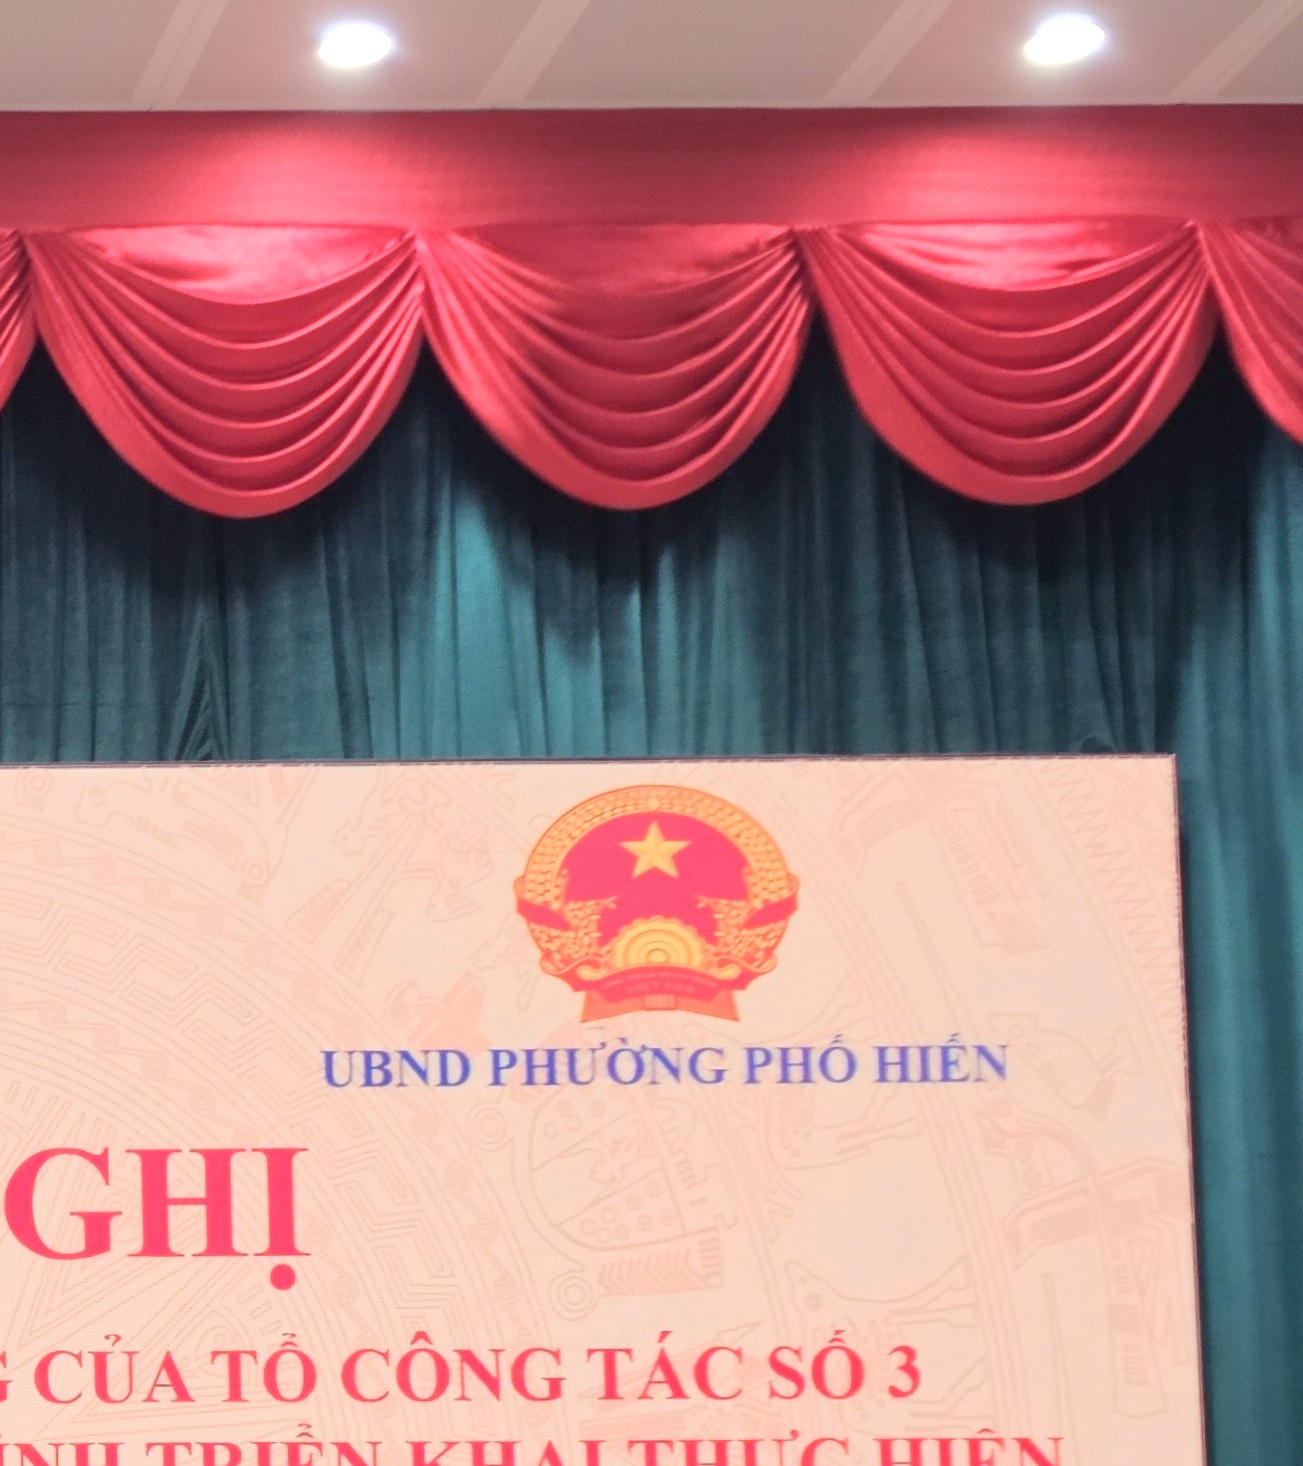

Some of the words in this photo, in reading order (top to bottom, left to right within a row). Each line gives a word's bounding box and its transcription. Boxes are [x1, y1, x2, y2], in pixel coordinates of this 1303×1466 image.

[322, 1049, 475, 1088] UBND
[489, 1038, 727, 1087] PHƯỜNG
[744, 1034, 861, 1085] PHỐ
[875, 1033, 1009, 1084] HIẾN
[32, 1333, 196, 1405] CỦA
[209, 1331, 320, 1404] TỔ
[339, 1330, 566, 1404] CÔNG
[585, 1330, 746, 1401] TÁC
[766, 1329, 868, 1401] SỐ
[886, 1344, 923, 1399] 3
